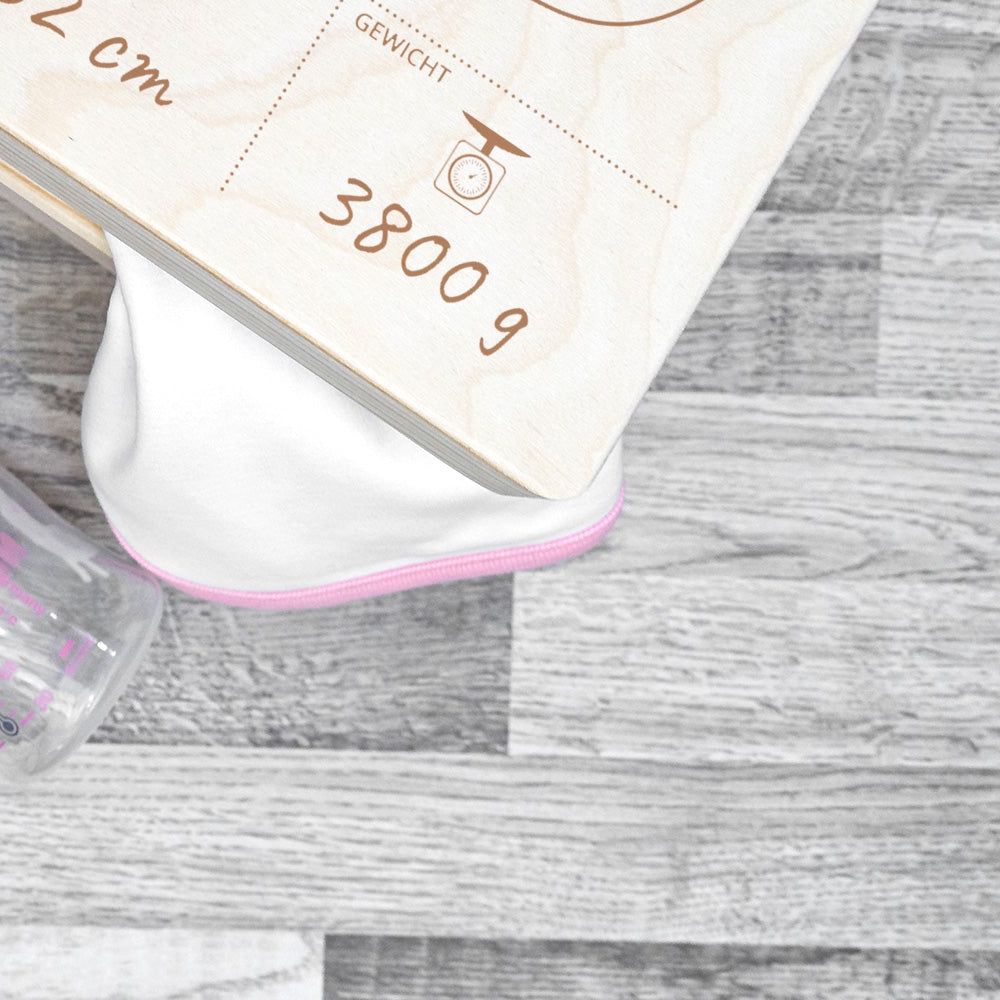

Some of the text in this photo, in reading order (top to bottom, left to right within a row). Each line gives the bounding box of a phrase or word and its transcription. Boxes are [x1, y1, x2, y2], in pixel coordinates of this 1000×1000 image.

[89, 36, 173, 106] cm
[354, 12, 452, 83] GEWICHT
[318, 177, 529, 356] 3800 g
